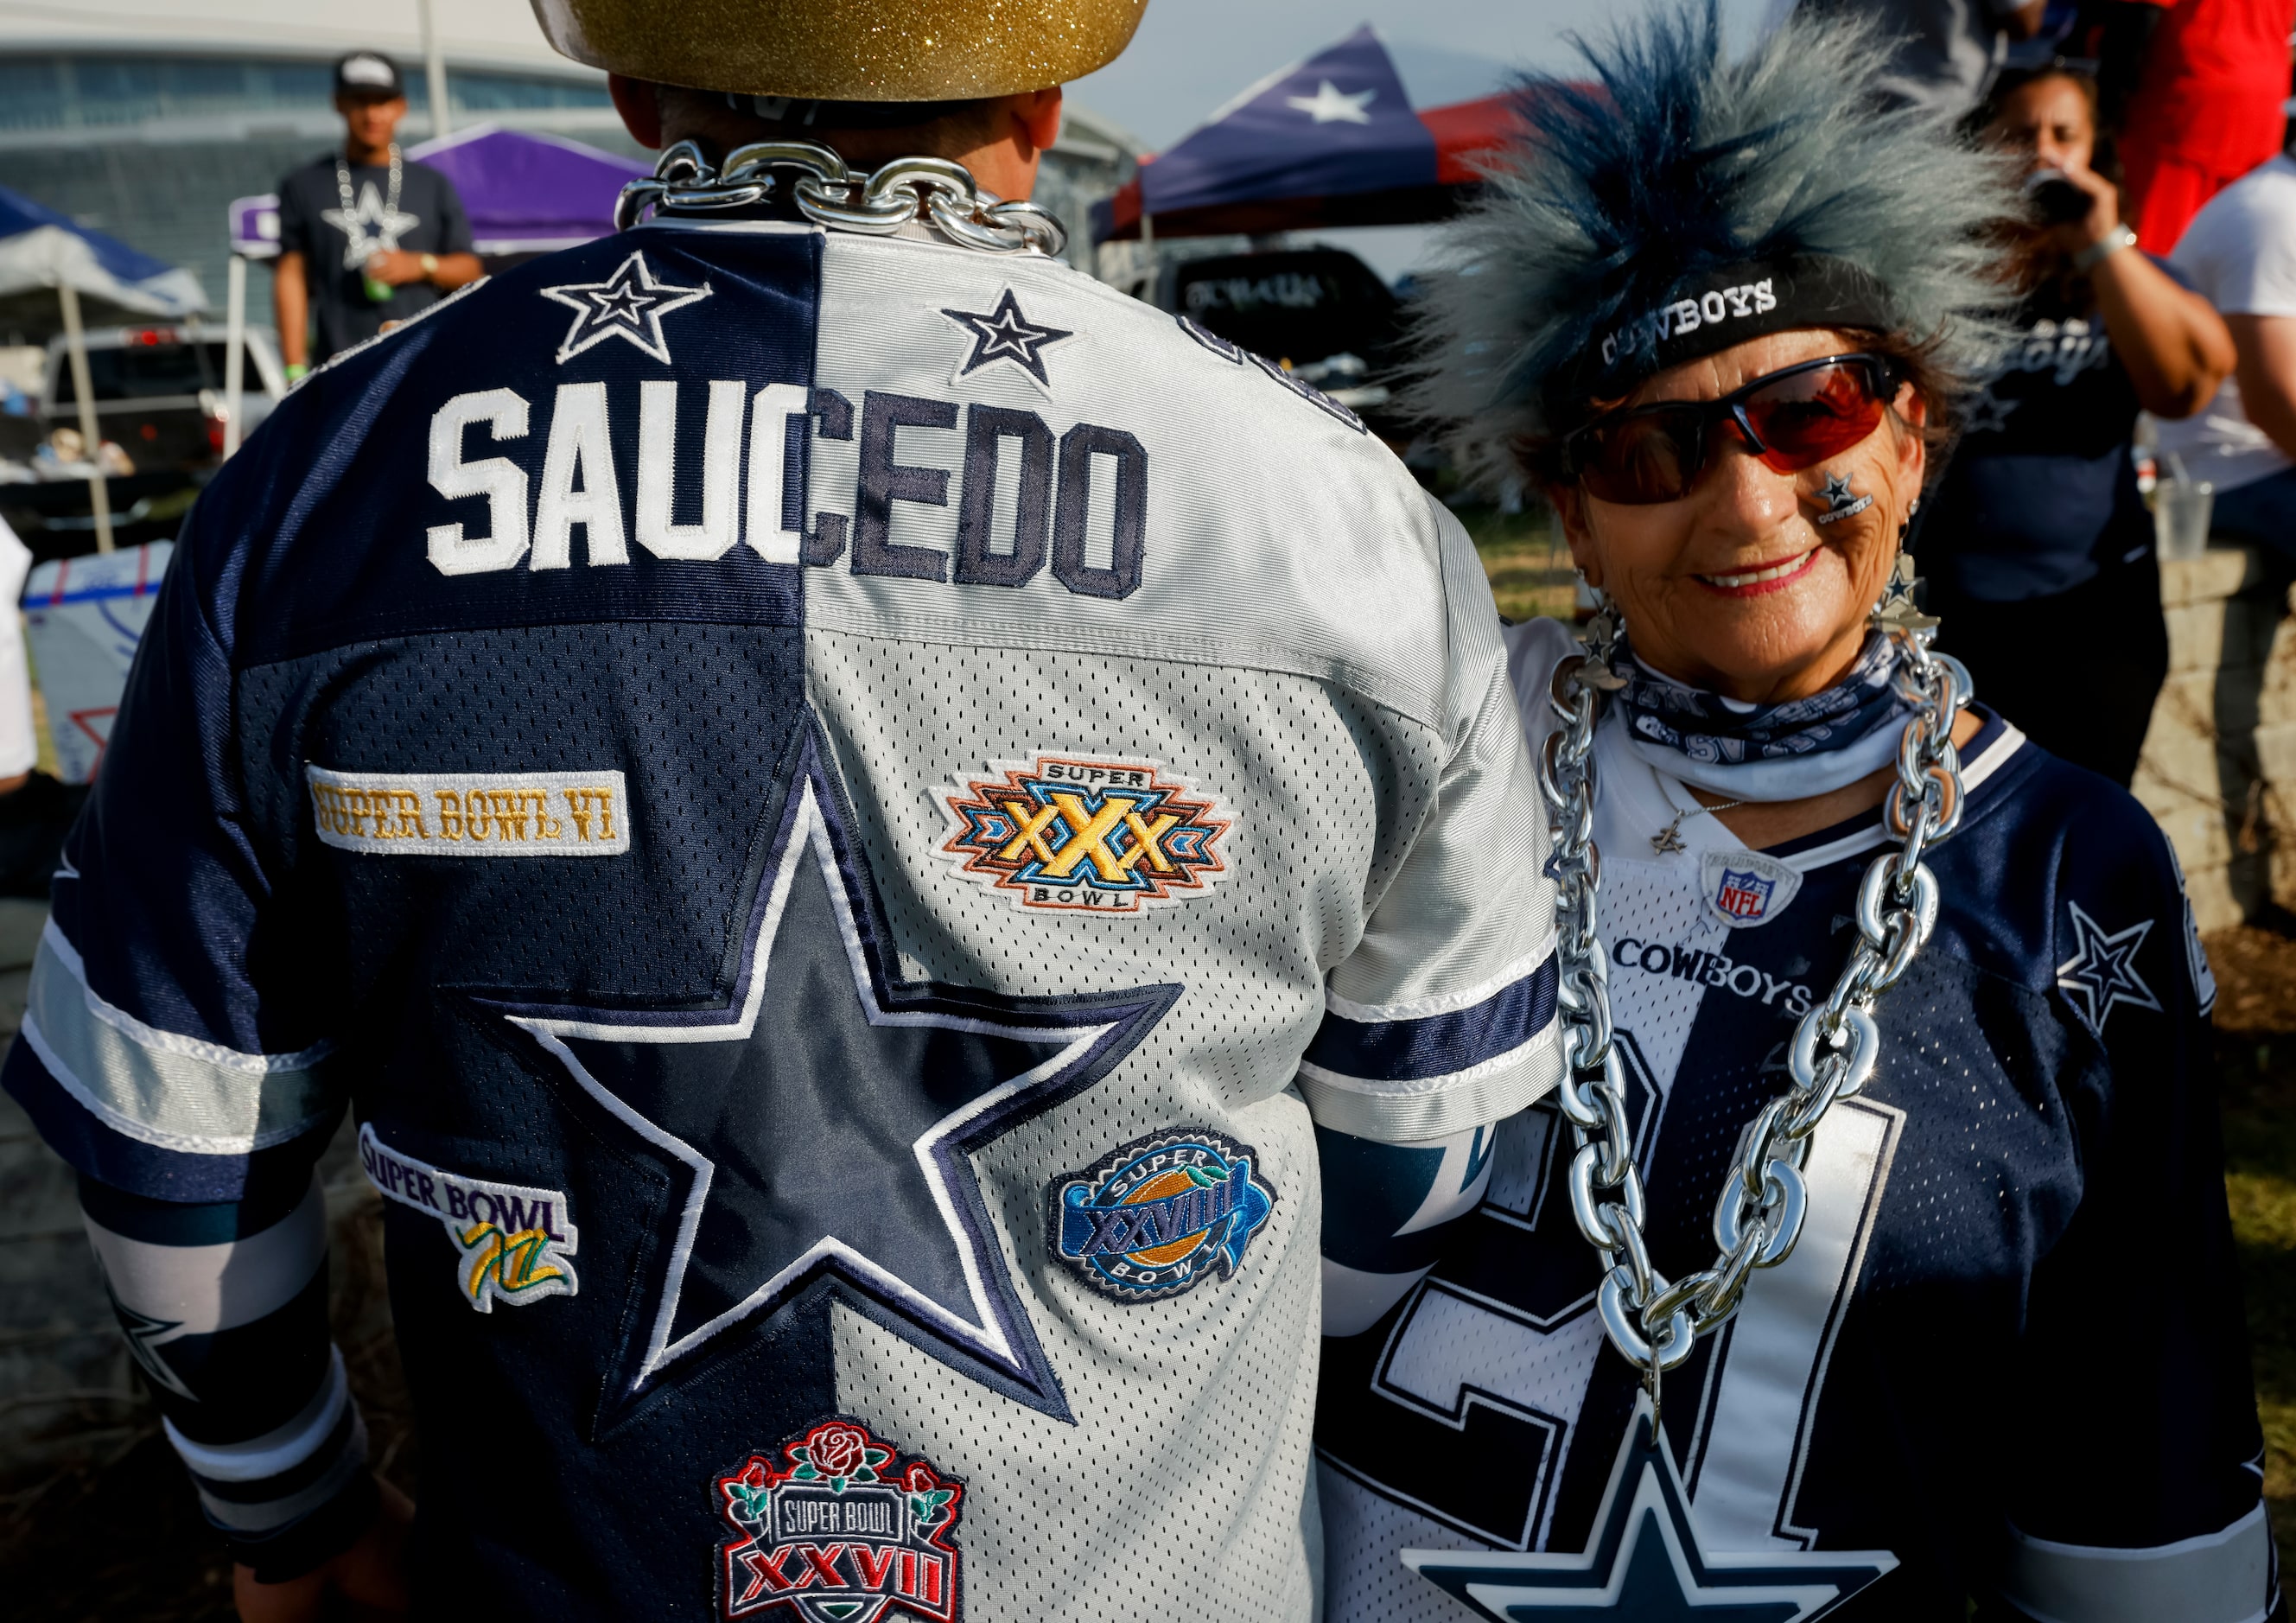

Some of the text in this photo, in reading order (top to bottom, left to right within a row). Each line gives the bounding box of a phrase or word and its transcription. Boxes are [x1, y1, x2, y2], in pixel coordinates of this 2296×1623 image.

[426, 380, 1148, 600] SAUCEDO
[1047, 764, 1147, 786] SUPER
[314, 782, 616, 842] SUPER BOWL VI
[996, 792, 1180, 882] XXX
[1034, 888, 1128, 907] BOWL
[1719, 886, 1763, 917] NFL
[1612, 937, 1814, 1016] COWBOYS
[361, 1132, 566, 1243] SUPER BOWL
[1112, 1149, 1207, 1199] SUPER
[785, 1499, 895, 1535] SUPER BOWL
[735, 1543, 944, 1607] XXVII
